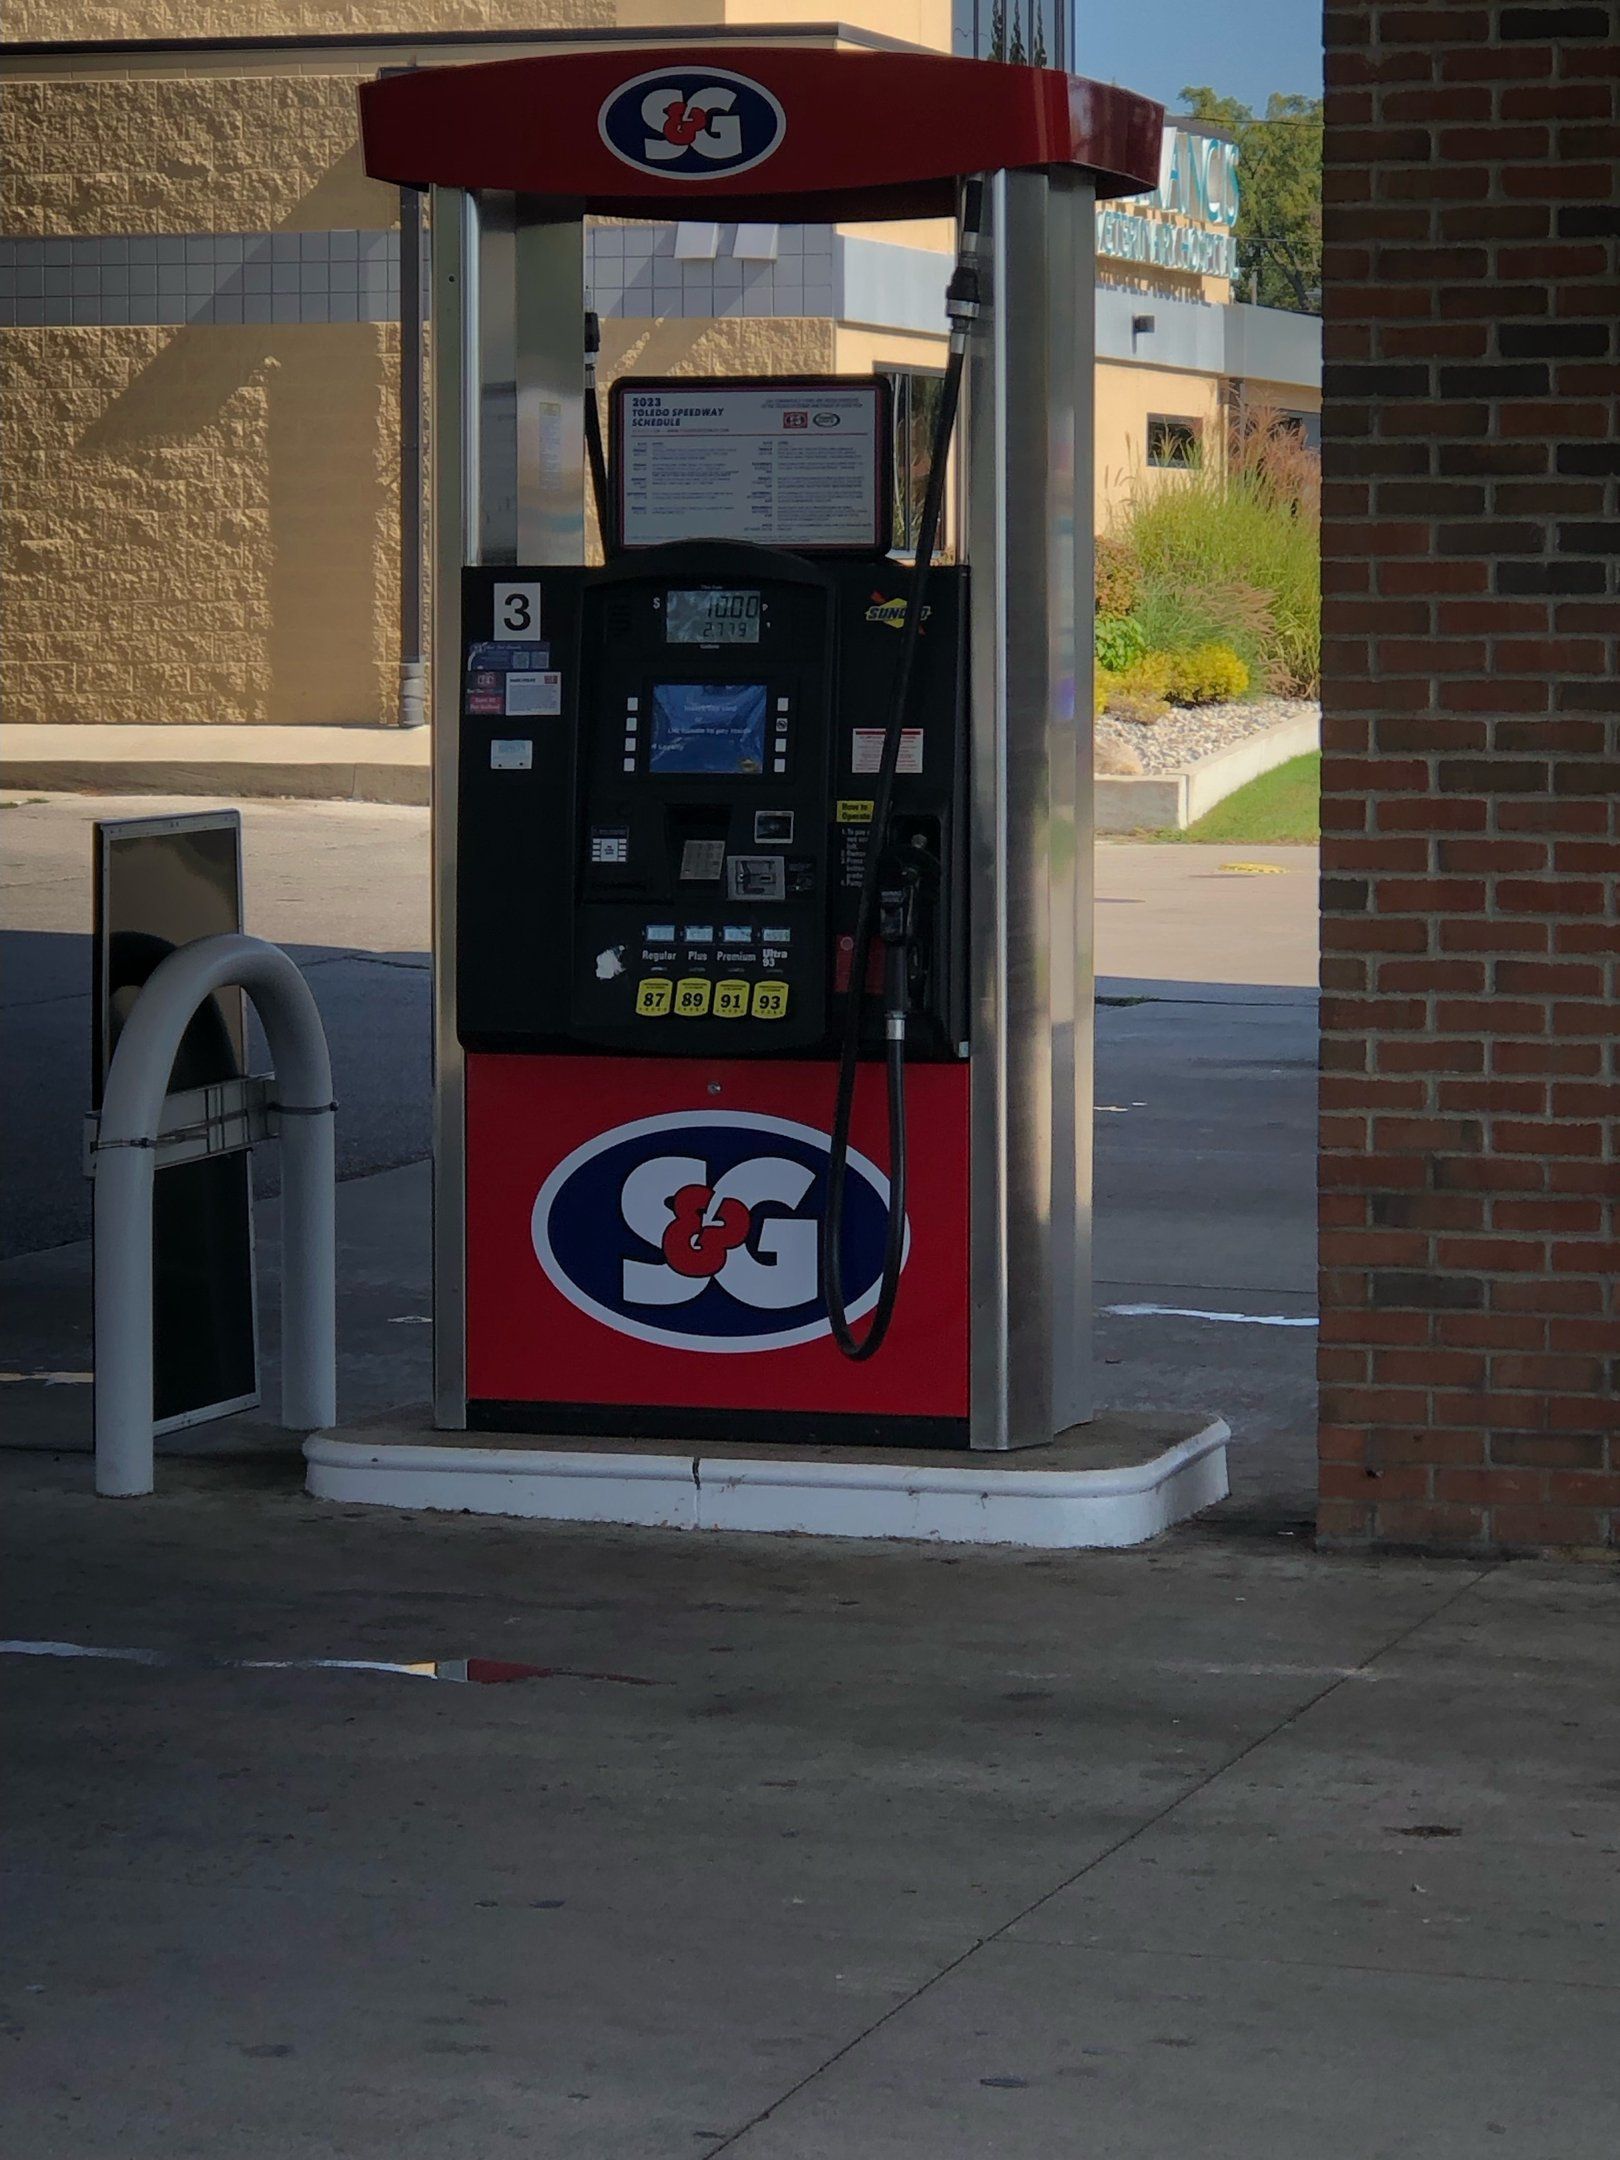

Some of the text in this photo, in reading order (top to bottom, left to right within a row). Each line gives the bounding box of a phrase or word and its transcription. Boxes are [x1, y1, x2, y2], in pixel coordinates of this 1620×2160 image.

[641, 87, 742, 160] S&G
[632, 397, 662, 407] 2023
[632, 407, 724, 417] TOLEDO SPEEDWAY
[632, 418, 681, 427] SCHEDULE
[503, 593, 532, 631] 3
[842, 803, 868, 811] How to
[842, 813, 870, 821] Operate
[642, 950, 678, 962] Regular
[688, 950, 708, 962] Plus
[716, 950, 757, 962] Premium
[762, 948, 789, 958] Ultra
[762, 958, 776, 968] 93
[643, 992, 665, 1007] 87
[682, 992, 704, 1007] 89
[721, 994, 741, 1009] 91
[759, 995, 781, 1010] 93
[620, 1156, 819, 1310] S&G
